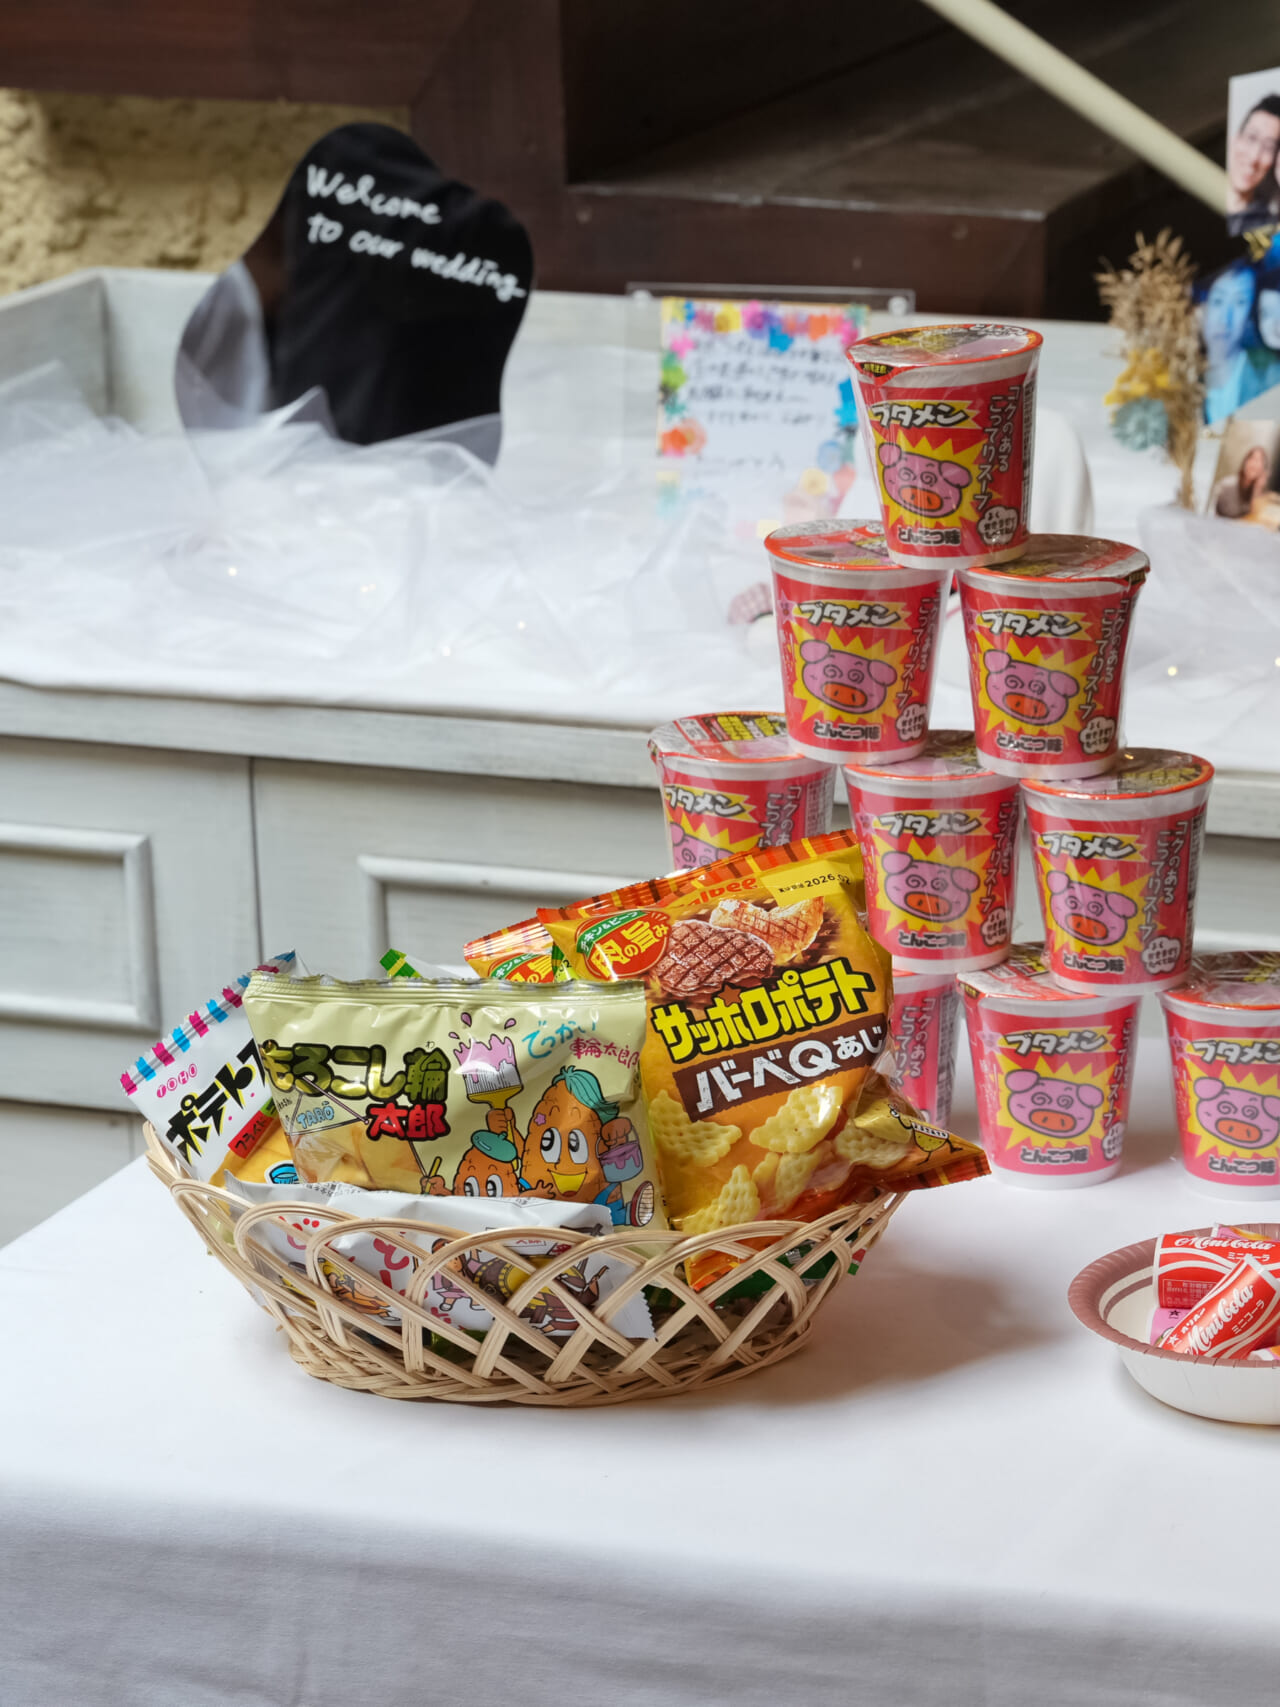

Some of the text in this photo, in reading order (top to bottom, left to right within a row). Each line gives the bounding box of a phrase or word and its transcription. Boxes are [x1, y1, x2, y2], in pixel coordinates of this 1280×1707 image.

[307, 163, 442, 224] Welcome
[349, 230, 404, 259] our
[410, 247, 527, 302] wedding
[870, 402, 968, 428] ブタメン
[998, 385, 1021, 472] コクのある
[974, 395, 1004, 511] こってりスープ
[898, 527, 961, 545] とんこつ味
[798, 602, 902, 628] ブタメン
[980, 611, 1082, 638] ブタメン
[896, 597, 932, 708] こってりスープ
[1079, 607, 1115, 720] こってりスープ
[813, 721, 881, 740] とんこつ味
[996, 731, 1063, 753] とんこつ味
[665, 785, 746, 818] ブタメン
[878, 812, 982, 838] ブタメン
[981, 801, 1012, 914] こってりスープ
[1040, 832, 1138, 859] ブタメン
[1163, 819, 1189, 904] コクのある
[1138, 829, 1172, 942] こってりスープ
[898, 931, 967, 948] とんこつ味
[1062, 953, 1126, 974] とんこつ味
[653, 959, 871, 1063] サッポロポテト
[522, 1019, 598, 1059] でっかい
[569, 1037, 639, 1069] 輪太郎
[909, 997, 937, 1078] コクのある
[1005, 1030, 1108, 1056] ブタメン
[156, 1063, 198, 1098] TOHO
[367, 1103, 451, 1141] 太郎
[1020, 1145, 1089, 1163] とんこつ味
[1208, 1156, 1276, 1174] とんこつ味
[1227, 1251, 1270, 1262] ミニーラ
[1231, 1299, 1265, 1335] ミニコーラ
